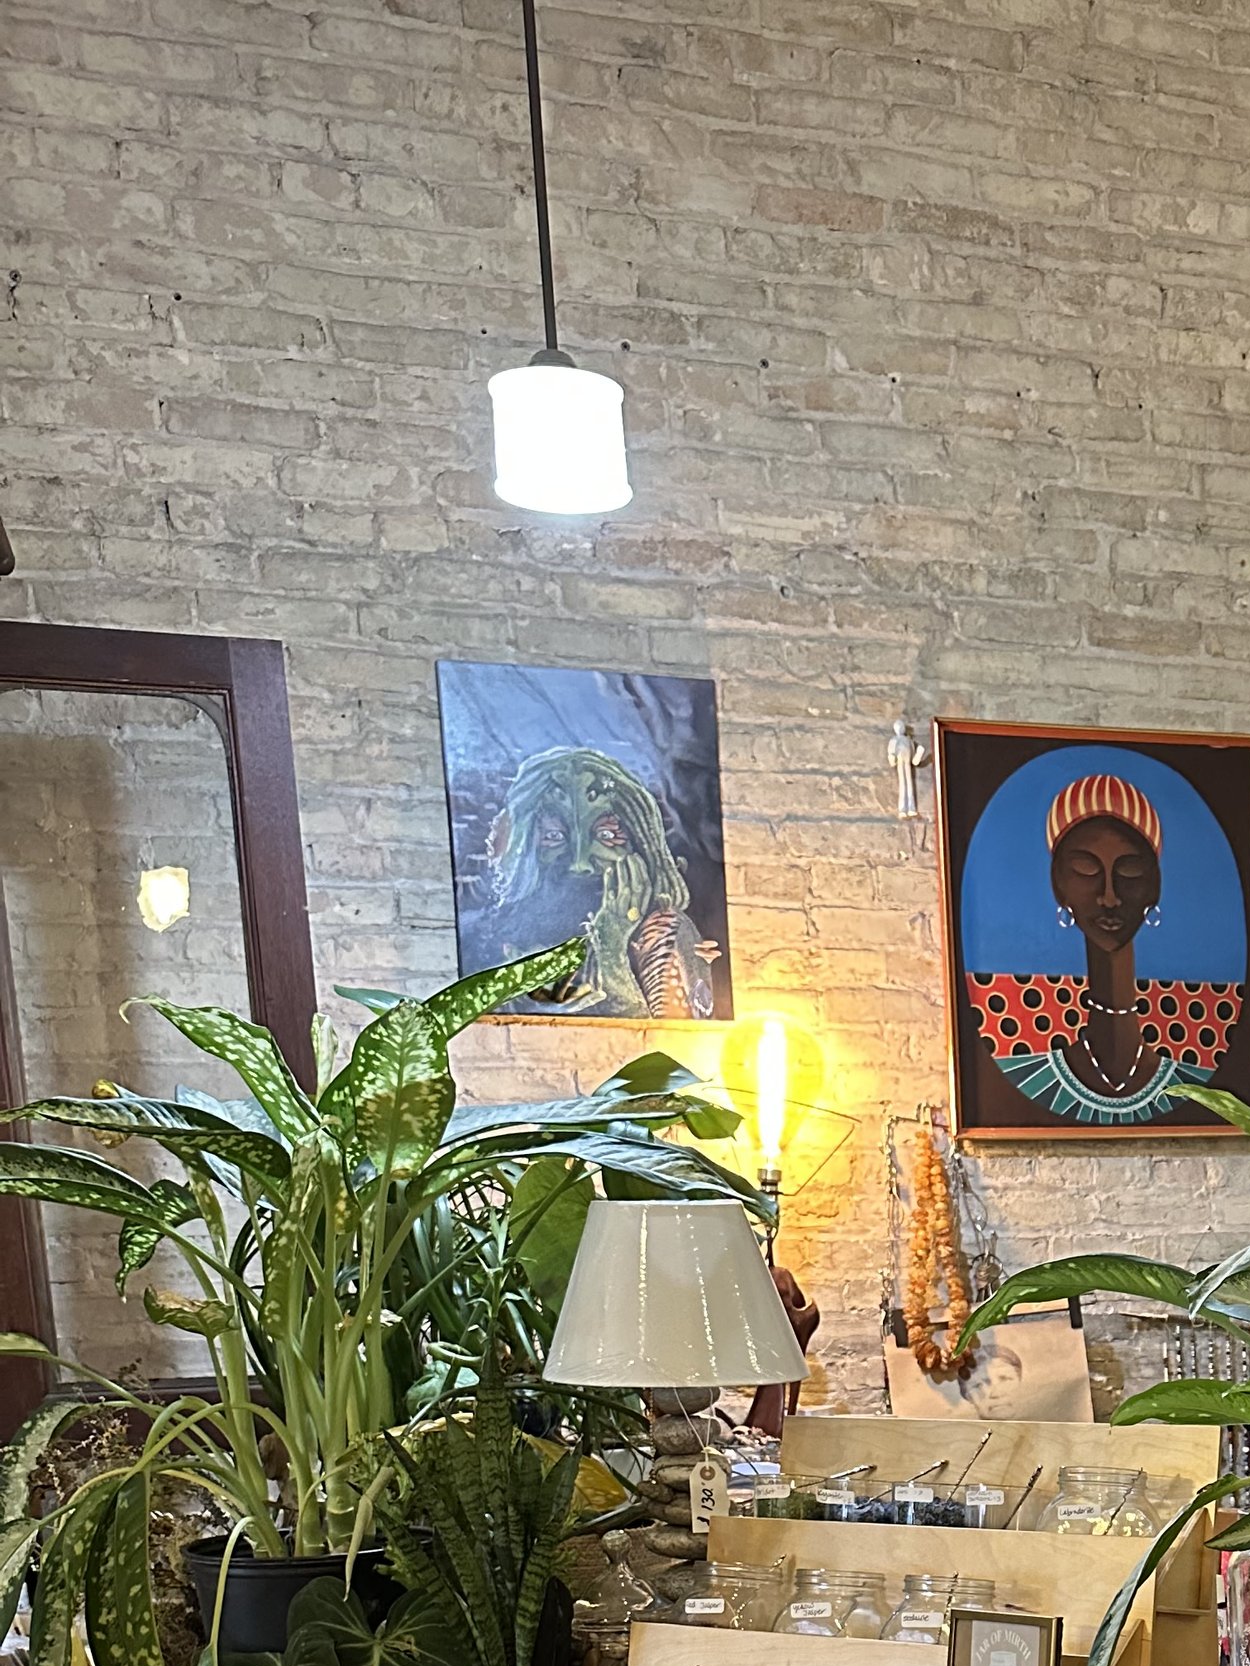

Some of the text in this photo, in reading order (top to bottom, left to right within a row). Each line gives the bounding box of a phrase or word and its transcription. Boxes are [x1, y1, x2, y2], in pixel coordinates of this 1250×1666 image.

[975, 1628, 1032, 1664] JAR OF MIRTH
